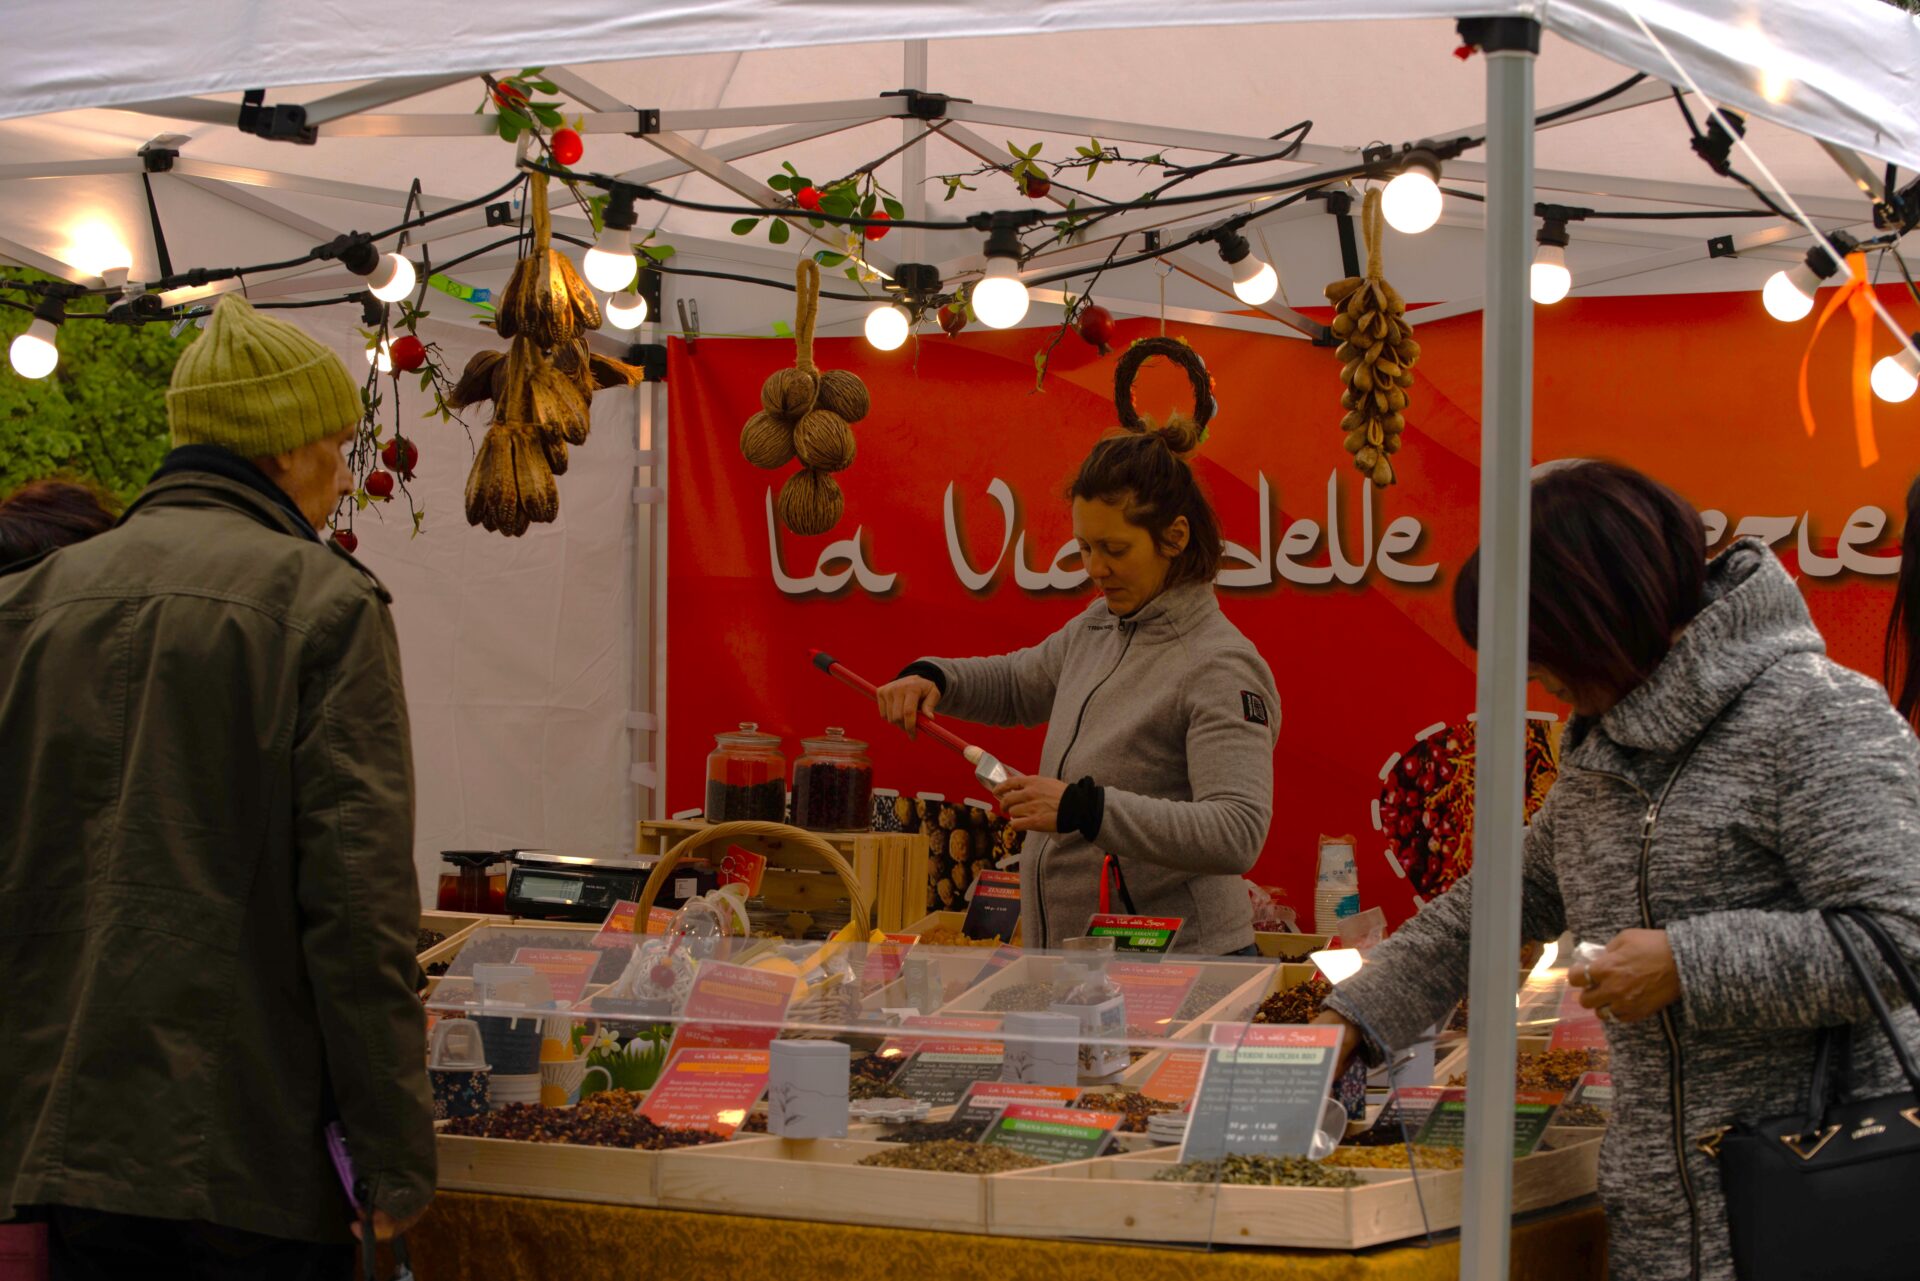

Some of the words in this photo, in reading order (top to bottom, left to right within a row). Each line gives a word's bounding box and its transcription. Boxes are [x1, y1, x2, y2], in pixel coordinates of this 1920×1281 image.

[765, 485, 898, 594] La
[1213, 466, 1440, 587] delle
[1137, 937, 1157, 945] BIO
